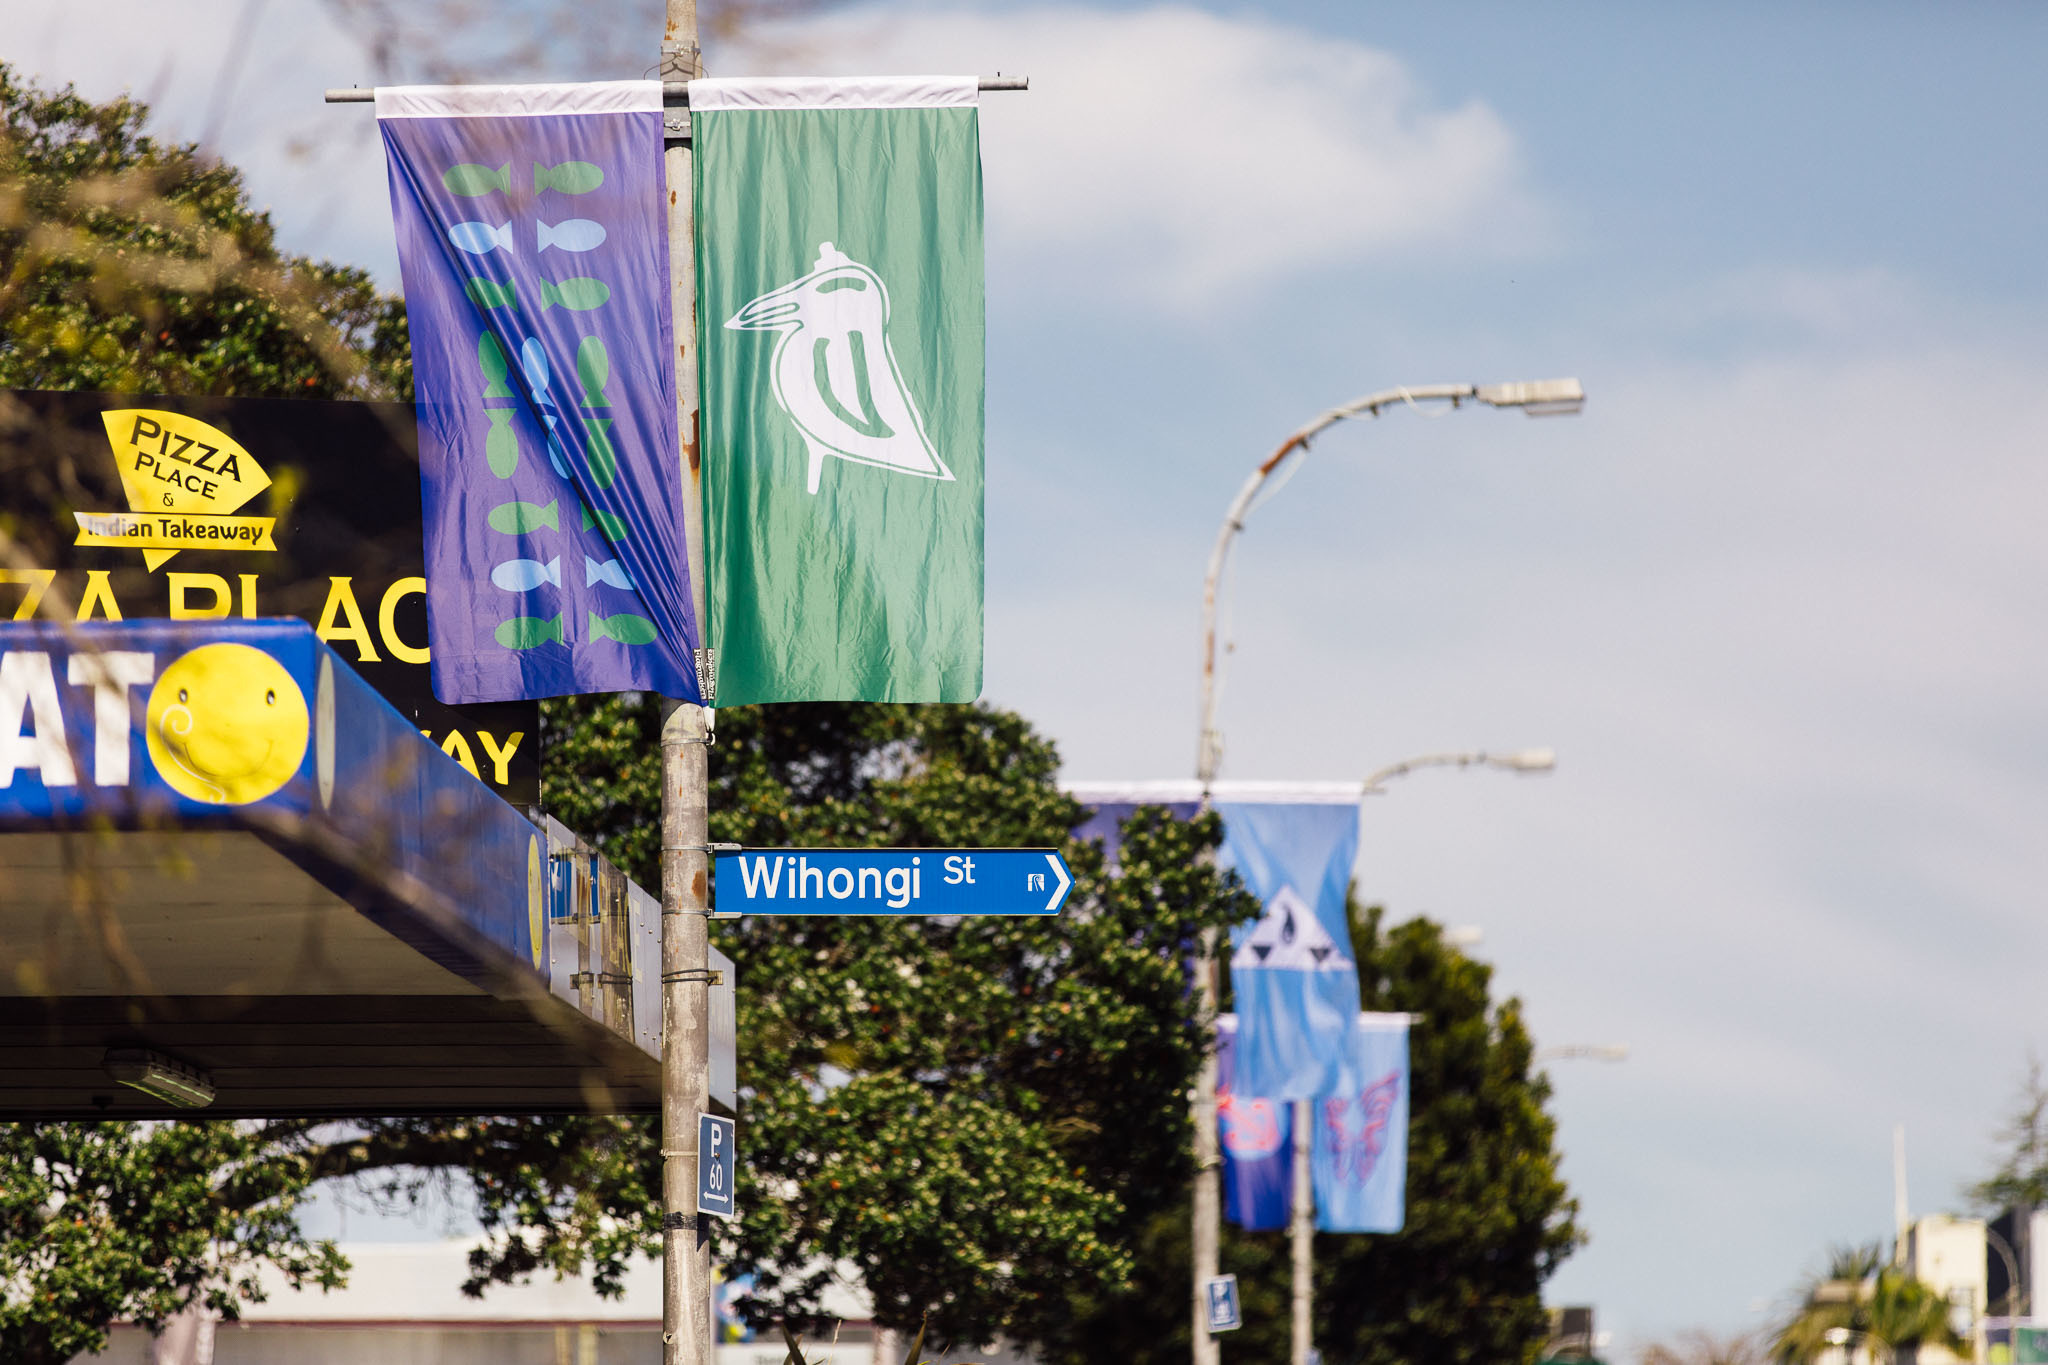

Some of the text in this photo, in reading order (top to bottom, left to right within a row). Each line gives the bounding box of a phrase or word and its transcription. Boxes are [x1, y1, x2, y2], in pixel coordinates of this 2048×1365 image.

[129, 415, 242, 483] PIZZA
[134, 451, 219, 500] PLACE
[162, 492, 175, 507] &
[87, 517, 264, 545] Indian Takeaway
[420, 729, 525, 785] AY
[738, 856, 976, 909] Wihongi St
[711, 1122, 722, 1158] P
[709, 1163, 723, 1191] 60
